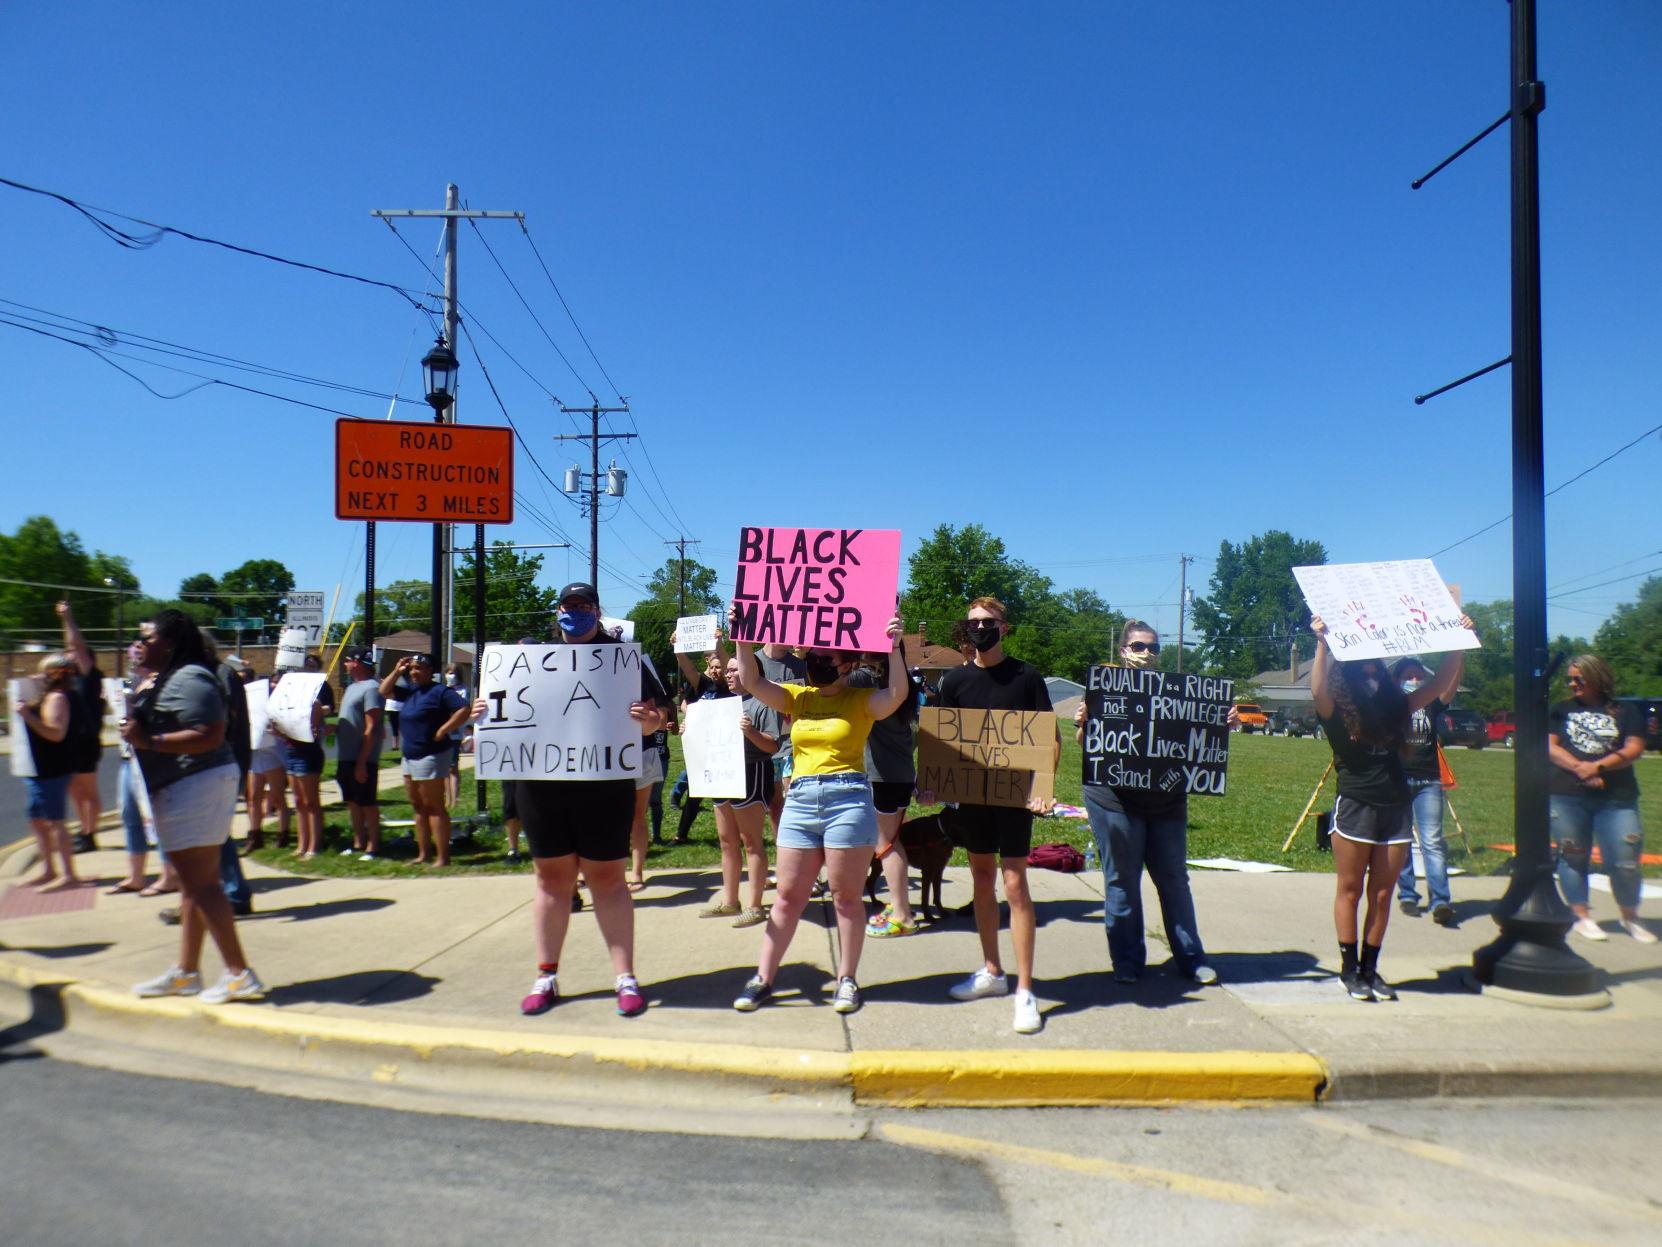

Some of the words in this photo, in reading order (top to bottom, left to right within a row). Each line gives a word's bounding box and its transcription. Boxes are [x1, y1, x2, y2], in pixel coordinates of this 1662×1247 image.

[400, 431, 453, 450] ROAD
[348, 460, 499, 484] CONSTRUCTION
[348, 491, 399, 511] NEXT
[416, 495, 427, 512] 3
[443, 496, 500, 515] MILES
[738, 527, 863, 566] BLACK
[289, 595, 322, 606] NORTH
[734, 565, 847, 604] LIVES
[683, 624, 707, 633] MATTER
[730, 601, 862, 649] MATTER
[683, 641, 707, 651] MATTER
[1383, 636, 1431, 653] #BLM
[484, 647, 640, 682] RACISM
[1089, 666, 1165, 695] EQUALITY
[1185, 675, 1235, 701] RIGHT
[489, 686, 535, 723] IS
[562, 680, 600, 716] A
[1103, 698, 1128, 714] not
[1136, 704, 1144, 713] a
[1150, 696, 1230, 726] PRIVILEGE
[937, 708, 1040, 746] BLACK
[1086, 718, 1142, 756] Black
[1147, 721, 1187, 759] Lives
[1188, 727, 1228, 764] Matter
[479, 740, 636, 774] PANDEMIC
[959, 744, 1011, 769] LIVES
[925, 766, 1025, 801] MATTER
[1088, 757, 1104, 785] I
[1107, 758, 1151, 789] Stand
[1159, 768, 1181, 791] with
